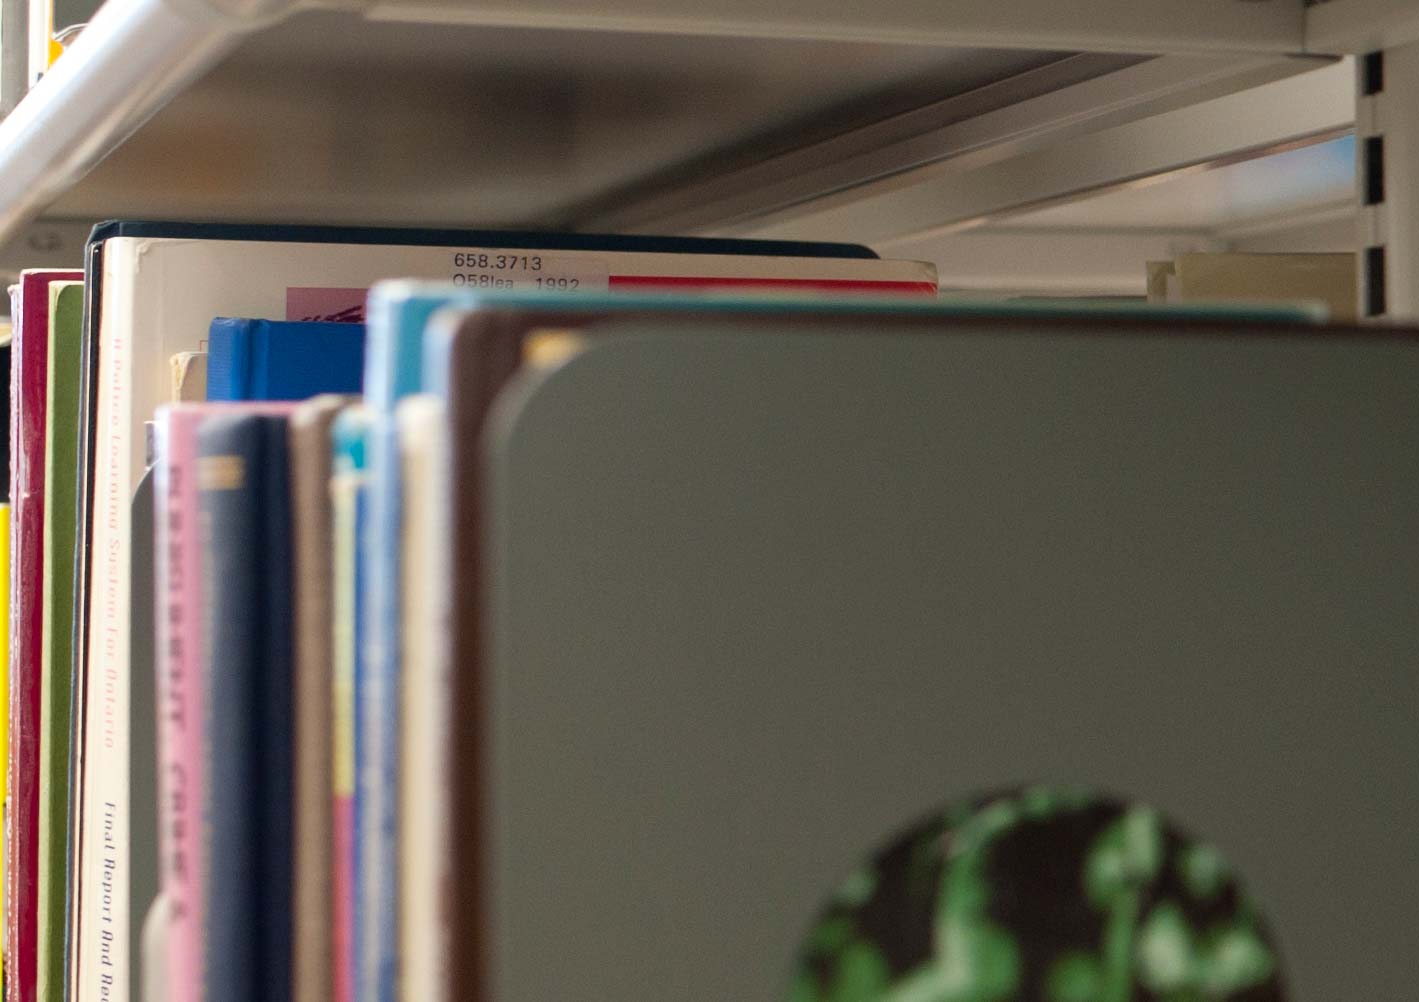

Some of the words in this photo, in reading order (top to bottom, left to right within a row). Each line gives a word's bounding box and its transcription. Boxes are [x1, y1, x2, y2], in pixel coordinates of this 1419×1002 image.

[454, 252, 542, 271] 658.3713
[536, 277, 580, 292] 1992
[103, 801, 117, 851] Final
[101, 857, 116, 923] Report
[100, 929, 114, 967] And
